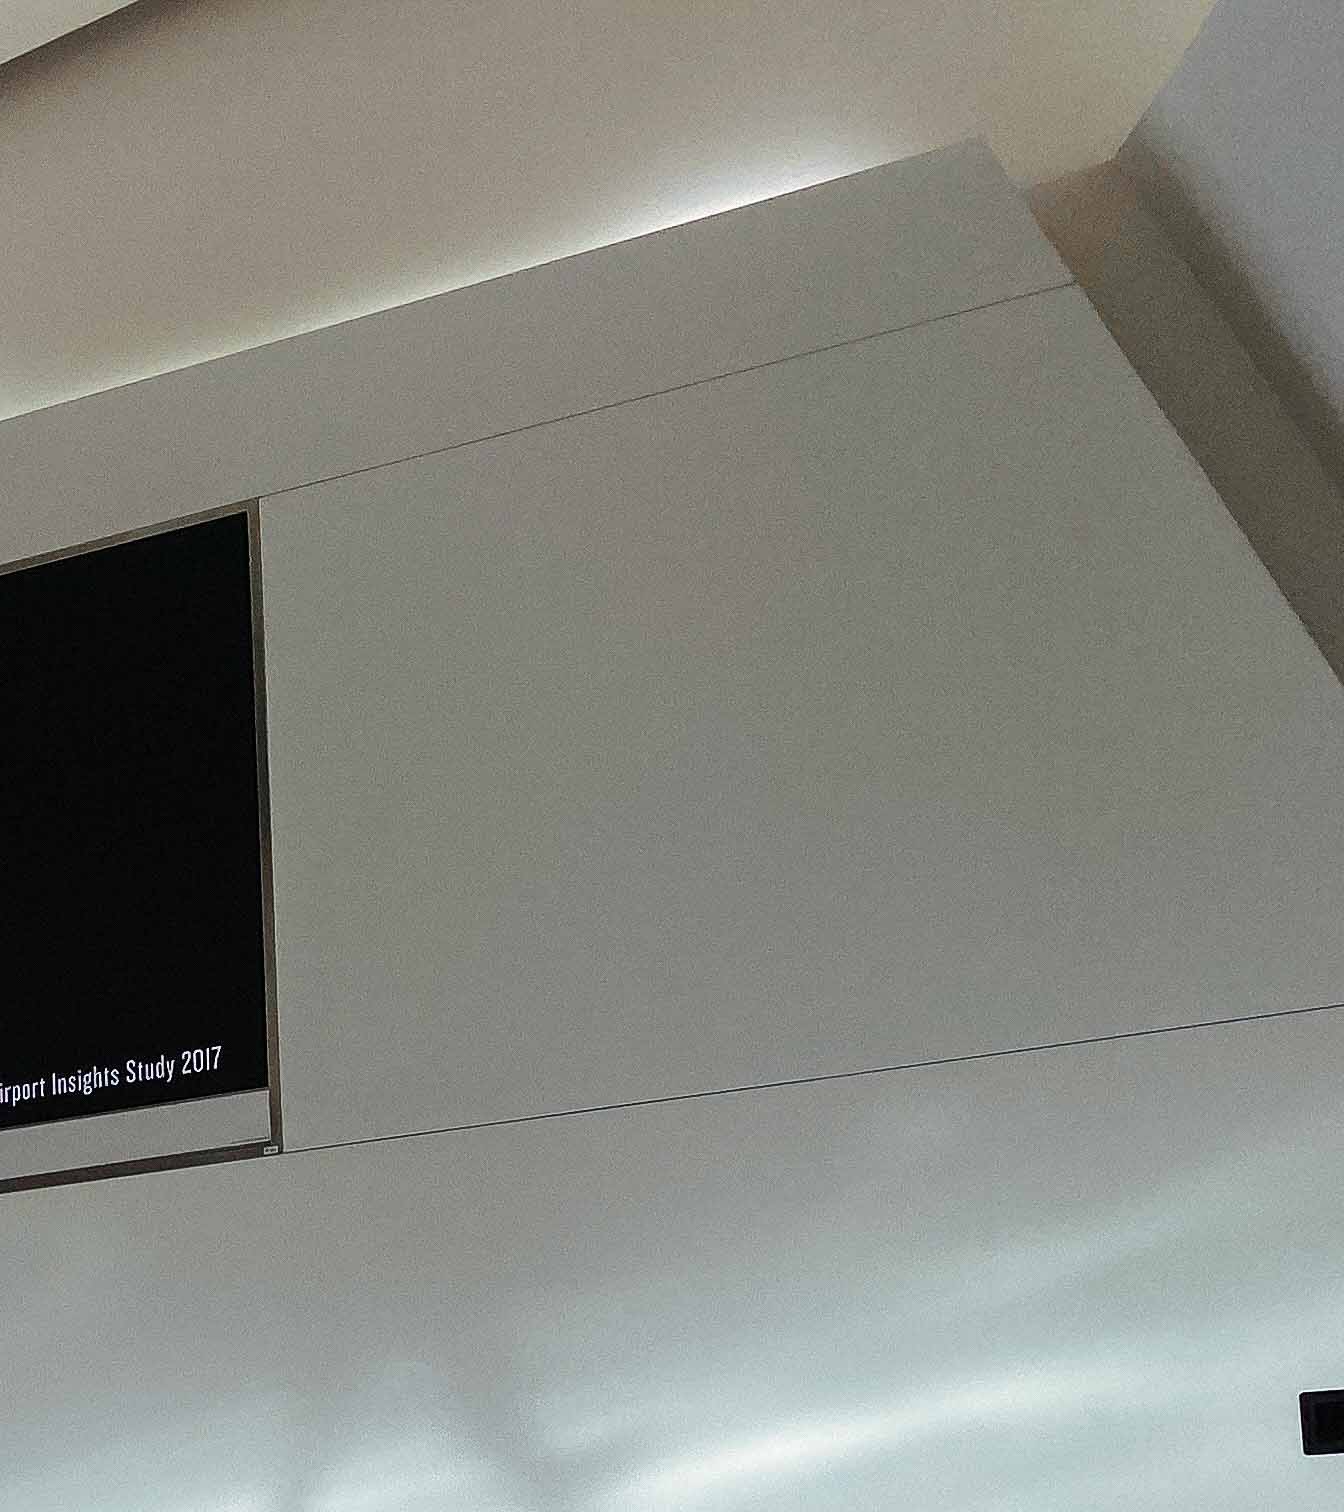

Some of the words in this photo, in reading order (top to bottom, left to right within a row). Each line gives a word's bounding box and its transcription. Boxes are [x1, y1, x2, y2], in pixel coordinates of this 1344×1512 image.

[51, 1065, 120, 1096] Insights
[125, 1055, 176, 1083] Study
[181, 1045, 222, 1075] 2017
